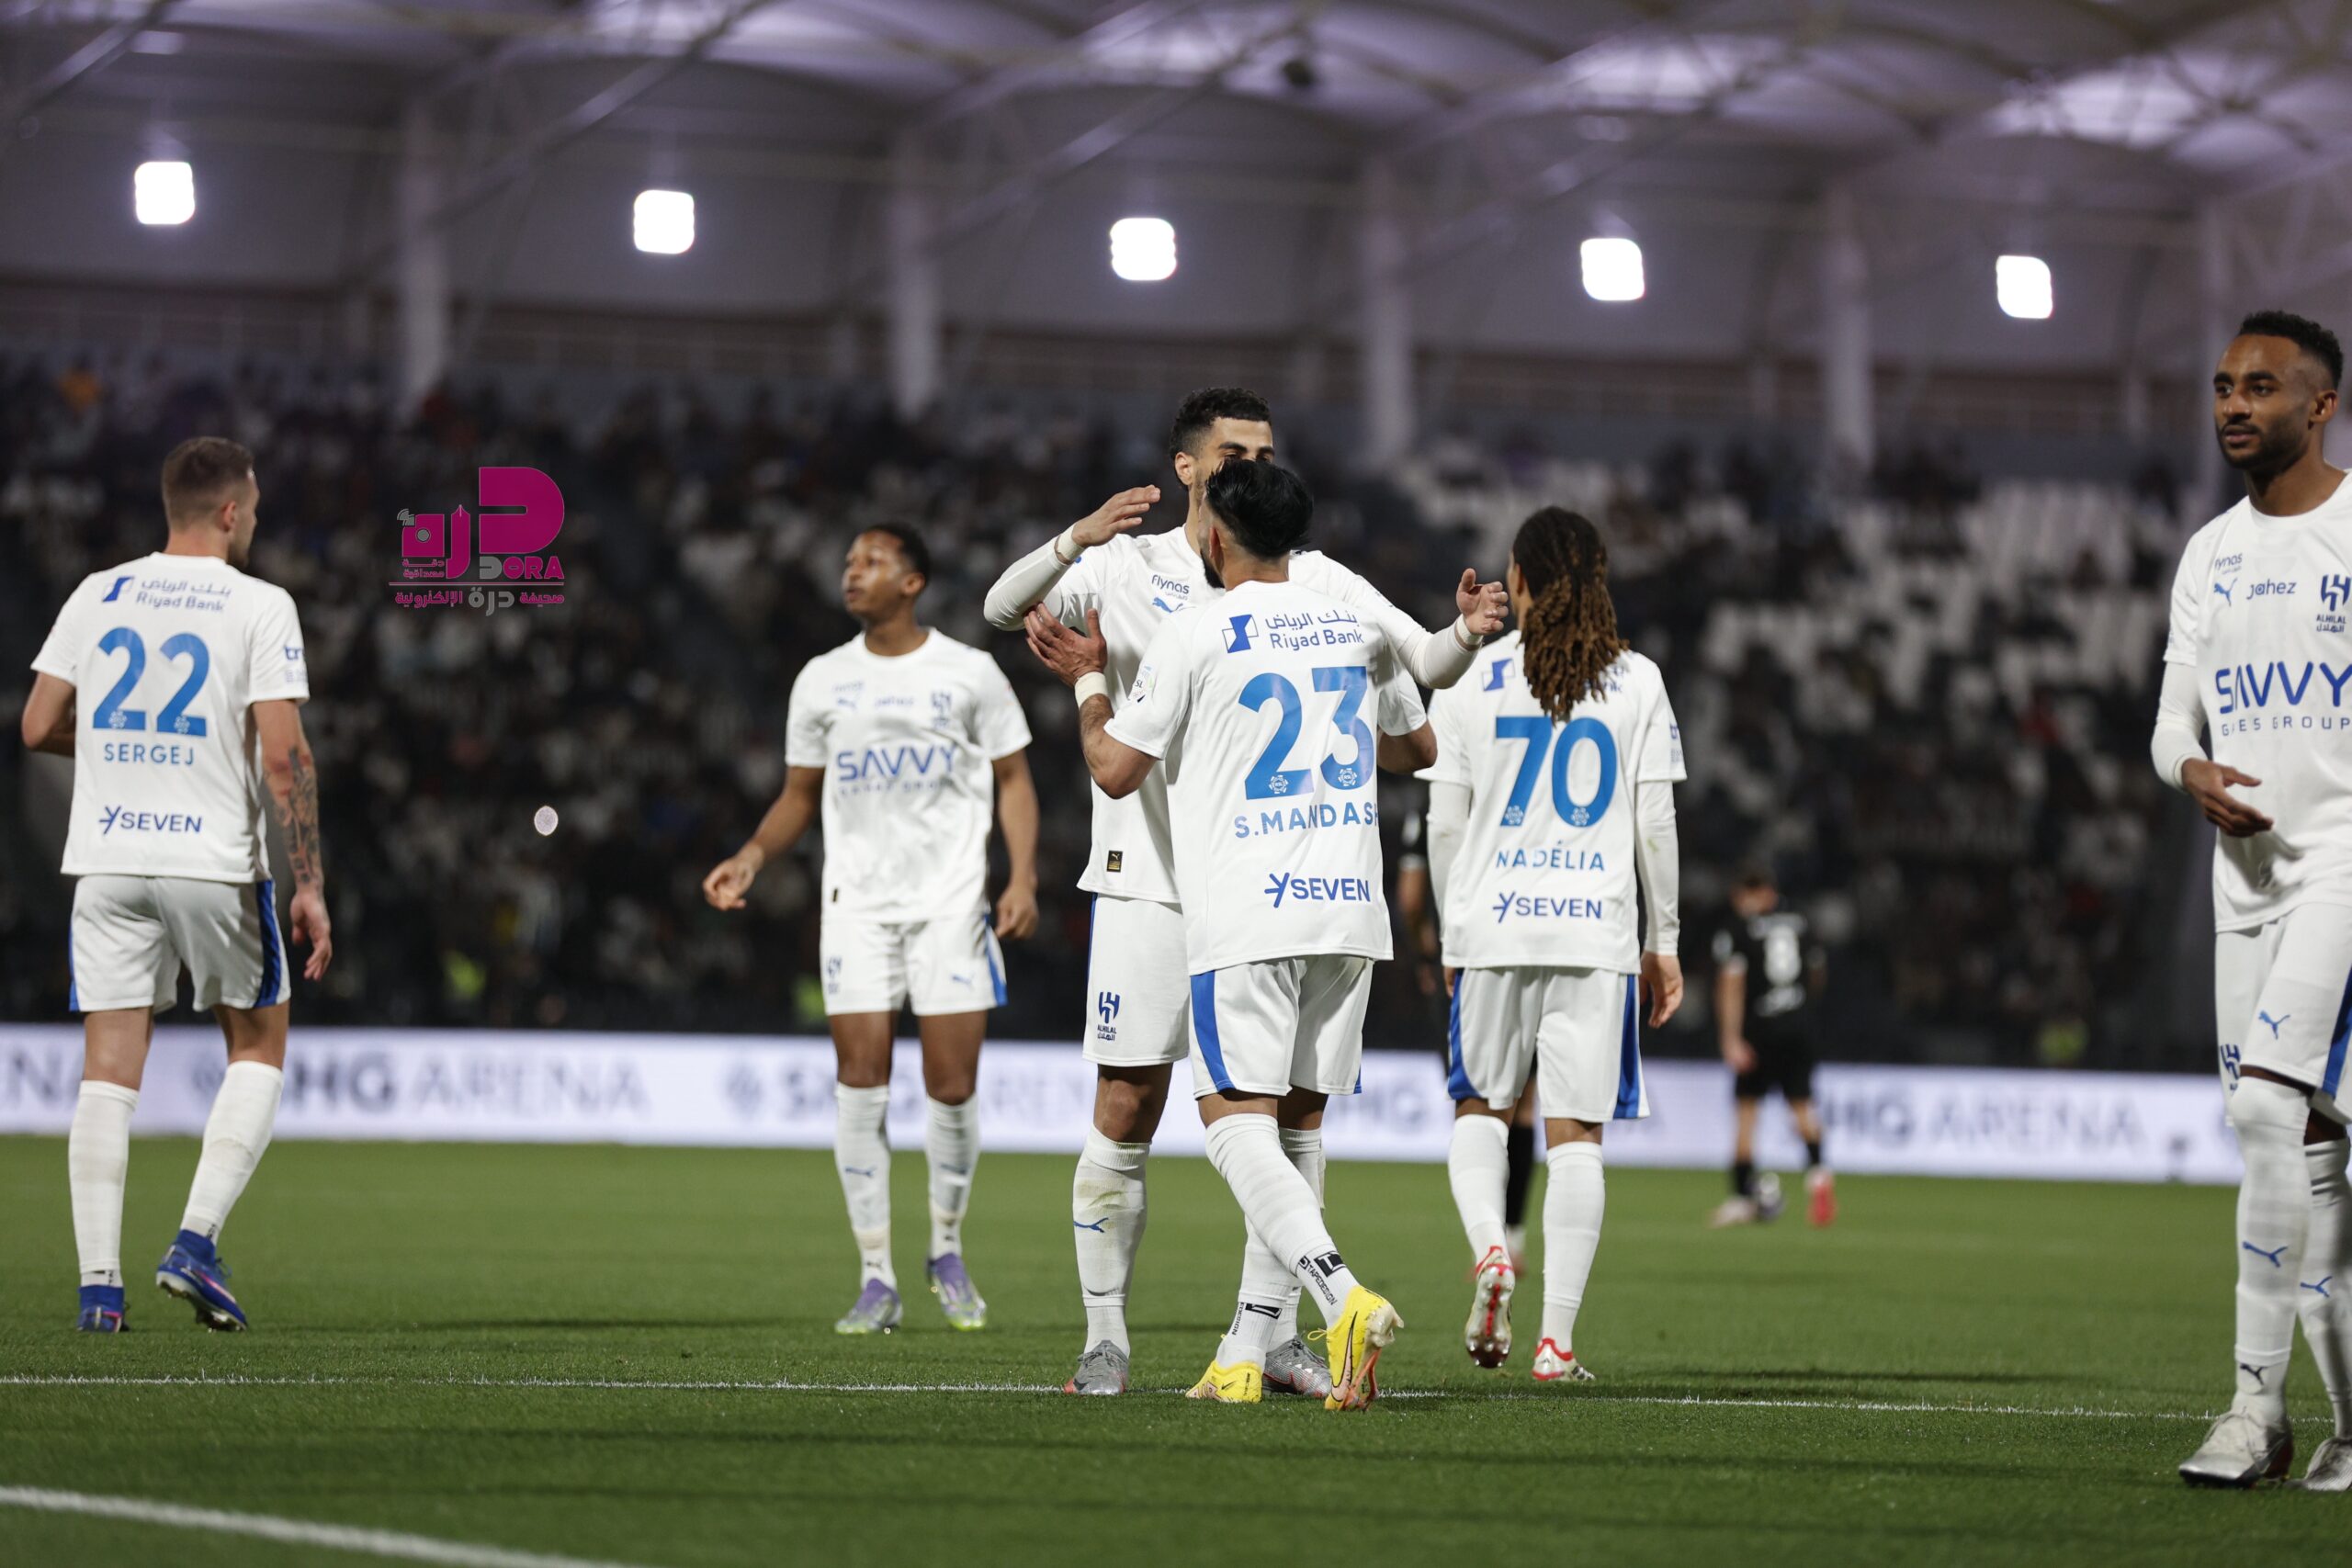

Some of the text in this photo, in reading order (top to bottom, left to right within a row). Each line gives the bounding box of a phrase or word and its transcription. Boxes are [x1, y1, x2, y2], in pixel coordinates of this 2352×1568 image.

[1151, 574, 1190, 594] flynas
[2245, 578, 2297, 600] jahez
[136, 591, 223, 611] Riyad Bank
[1265, 613, 1314, 631] الرياض
[1270, 628, 1365, 651] Riyad Bank
[93, 627, 210, 737] 22
[2215, 660, 2352, 715] SAVVY
[1238, 666, 1374, 800] 23
[2271, 715, 2351, 731] GROUP
[104, 742, 195, 767] SERGEJ
[836, 745, 956, 782] SAVVY
[1496, 716, 1617, 828] 70
[1496, 840, 1605, 872] NADÉLIA
